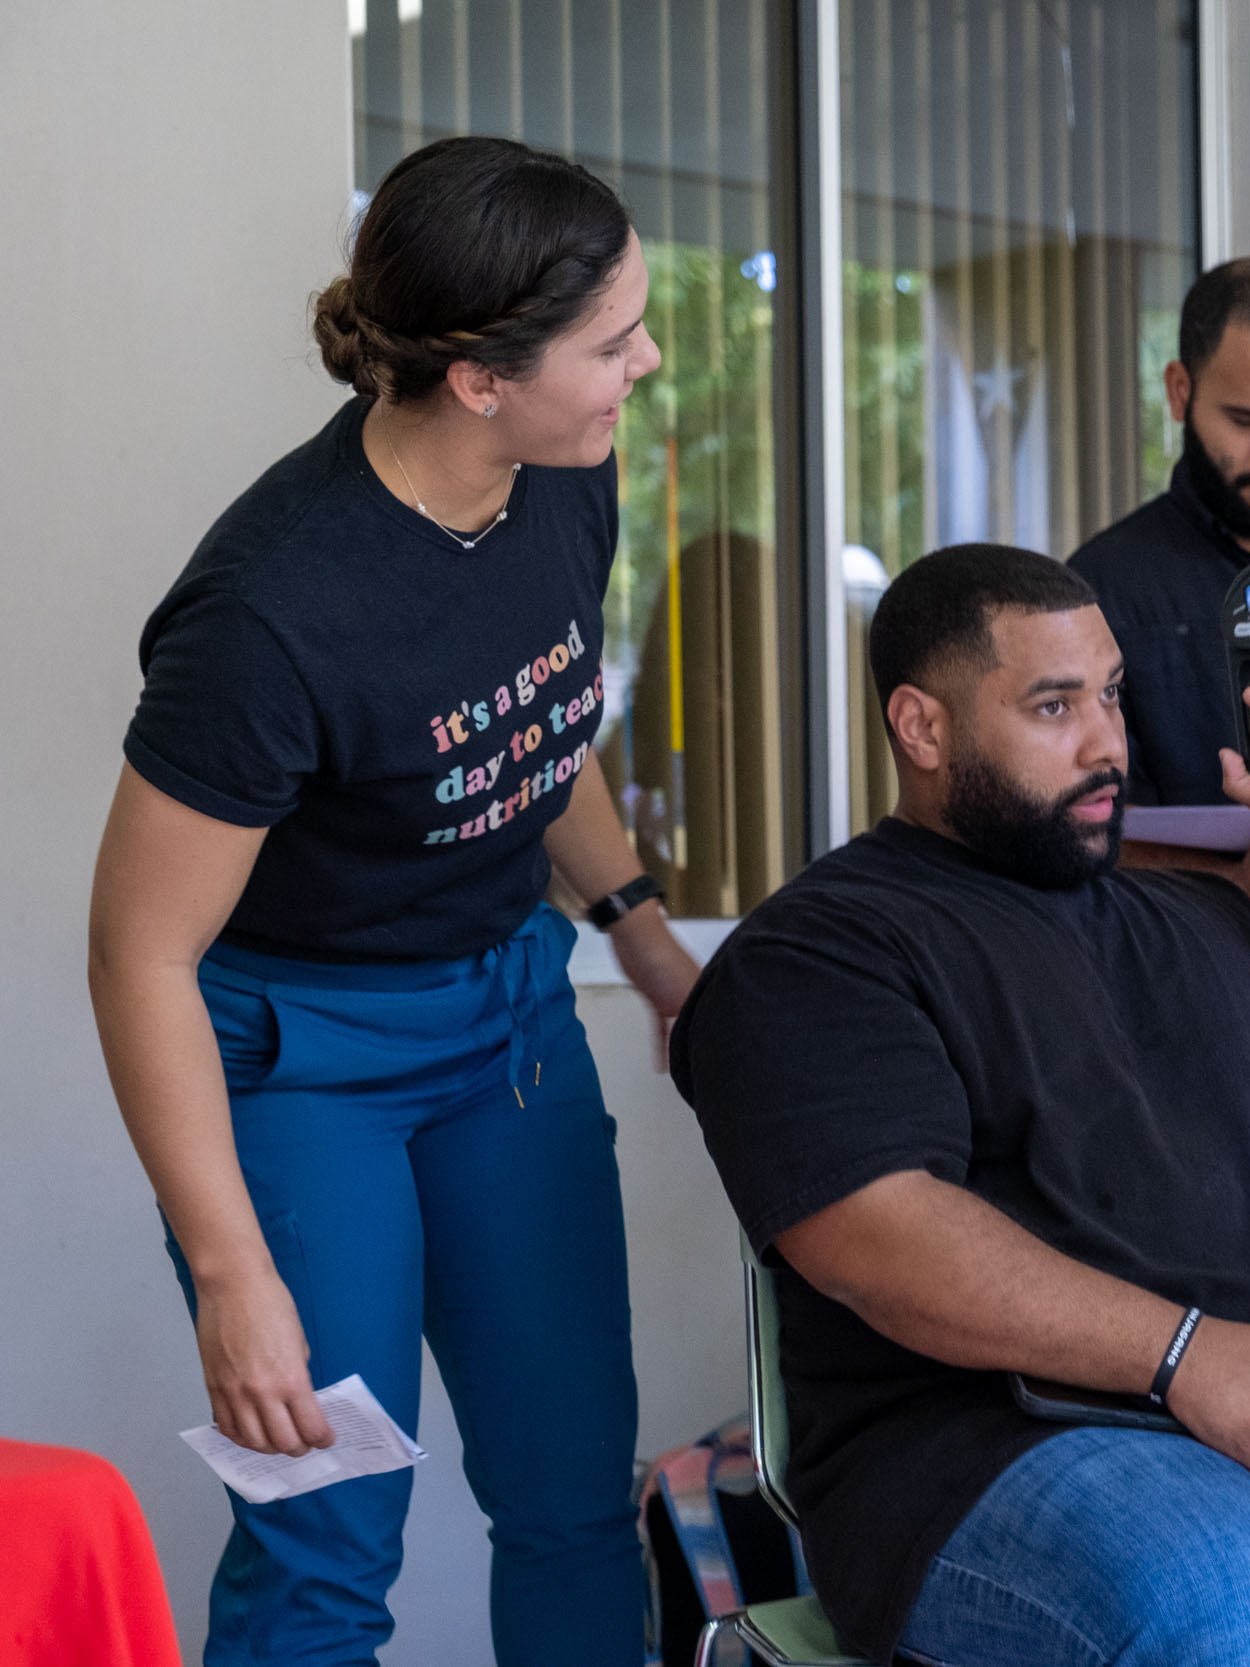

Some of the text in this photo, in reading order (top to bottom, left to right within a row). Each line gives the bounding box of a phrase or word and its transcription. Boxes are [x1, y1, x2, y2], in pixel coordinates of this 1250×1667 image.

[430, 619, 585, 753] it's a good
[435, 656, 603, 804] day to teac
[422, 741, 588, 845] nutrition
